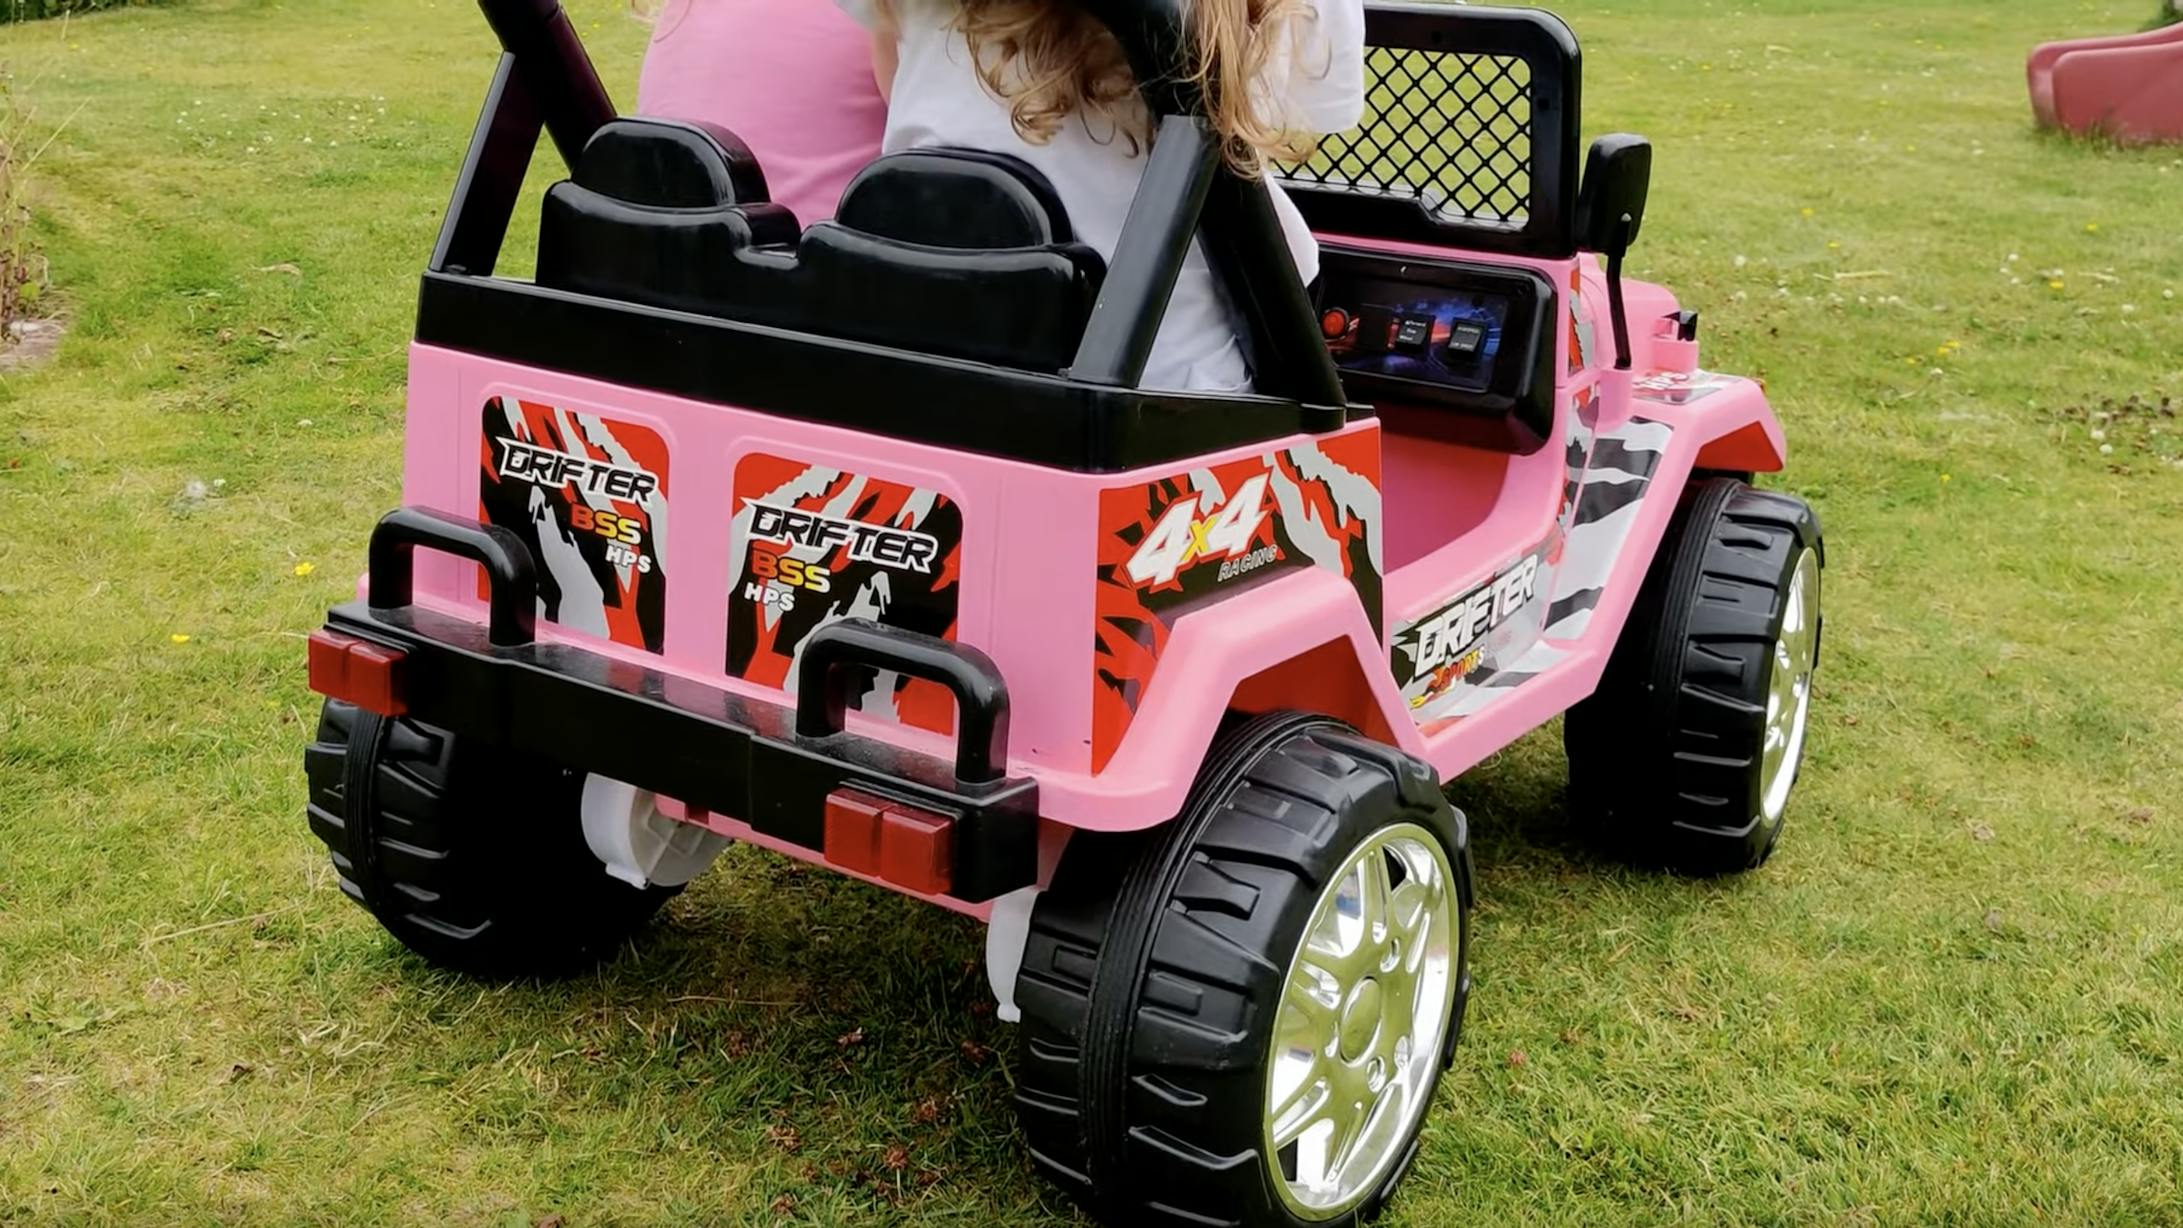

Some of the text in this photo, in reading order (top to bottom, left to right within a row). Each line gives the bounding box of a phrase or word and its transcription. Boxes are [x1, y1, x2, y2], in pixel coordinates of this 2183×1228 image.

[499, 438, 658, 505] DRIFTER
[571, 502, 642, 545] BSS
[744, 499, 937, 572] DRIFTER
[1126, 472, 1270, 587] 4x4
[605, 544, 652, 574] HPS
[751, 549, 831, 594] BSS
[1217, 544, 1278, 582] RACING
[744, 582, 796, 612] HPS
[1414, 553, 1538, 680] DRIFTER
